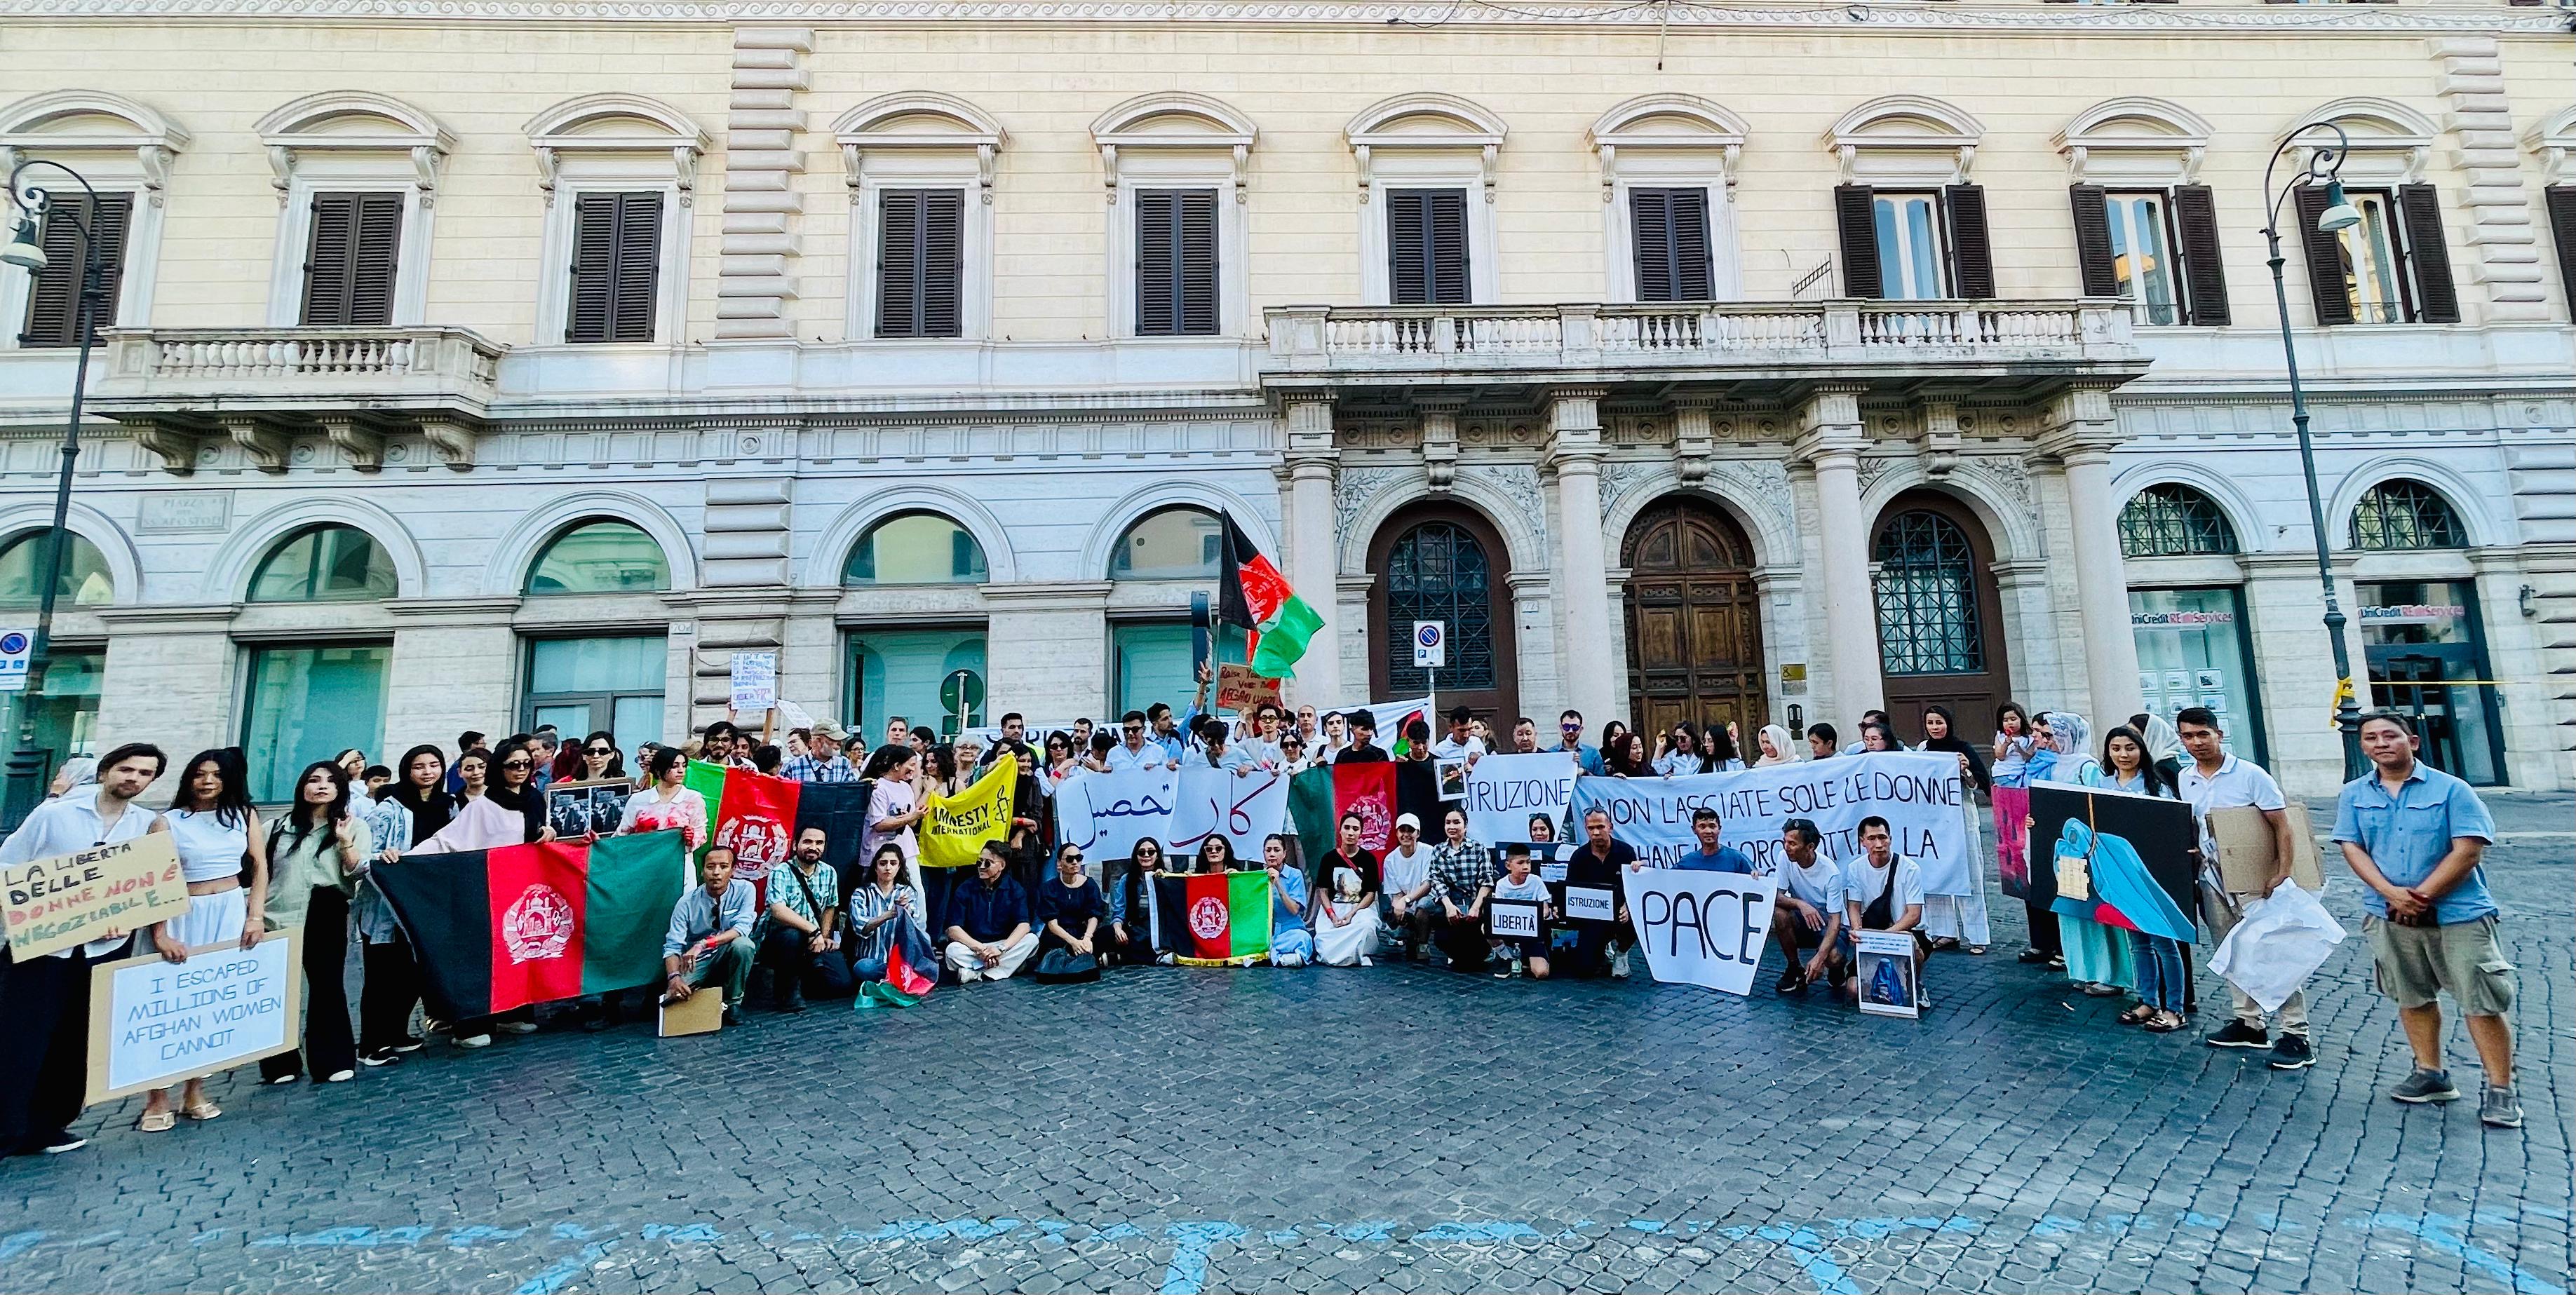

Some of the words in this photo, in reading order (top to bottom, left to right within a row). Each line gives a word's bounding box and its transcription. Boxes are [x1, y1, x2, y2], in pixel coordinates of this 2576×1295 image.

[2194, 612, 2234, 624] Services
[2361, 607, 2401, 617] UniCredit
[1169, 770, 1278, 848] کار
[1779, 780, 1836, 814] SOLE
[1845, 773, 1871, 804] LE
[1875, 772, 1961, 806] DONNE
[933, 803, 988, 827] AMNESTY
[1903, 827, 1938, 860] LA
[5, 865, 45, 887] LA
[9, 867, 104, 905] DELLE
[8, 886, 95, 926] DONNE
[104, 871, 154, 898] NON
[1567, 896, 1610, 909] ISTRUZIONE
[1492, 913, 1535, 932] LIBERTÀ
[1642, 889, 1764, 965] PACE
[150, 977, 166, 995] I
[177, 959, 259, 989] ESCAPED
[128, 984, 236, 1022] MILLIONS
[247, 977, 268, 996] OF
[123, 1015, 201, 1046] AFGHAN
[213, 995, 281, 1024] WOMEN
[161, 1028, 235, 1061] CANNOT
